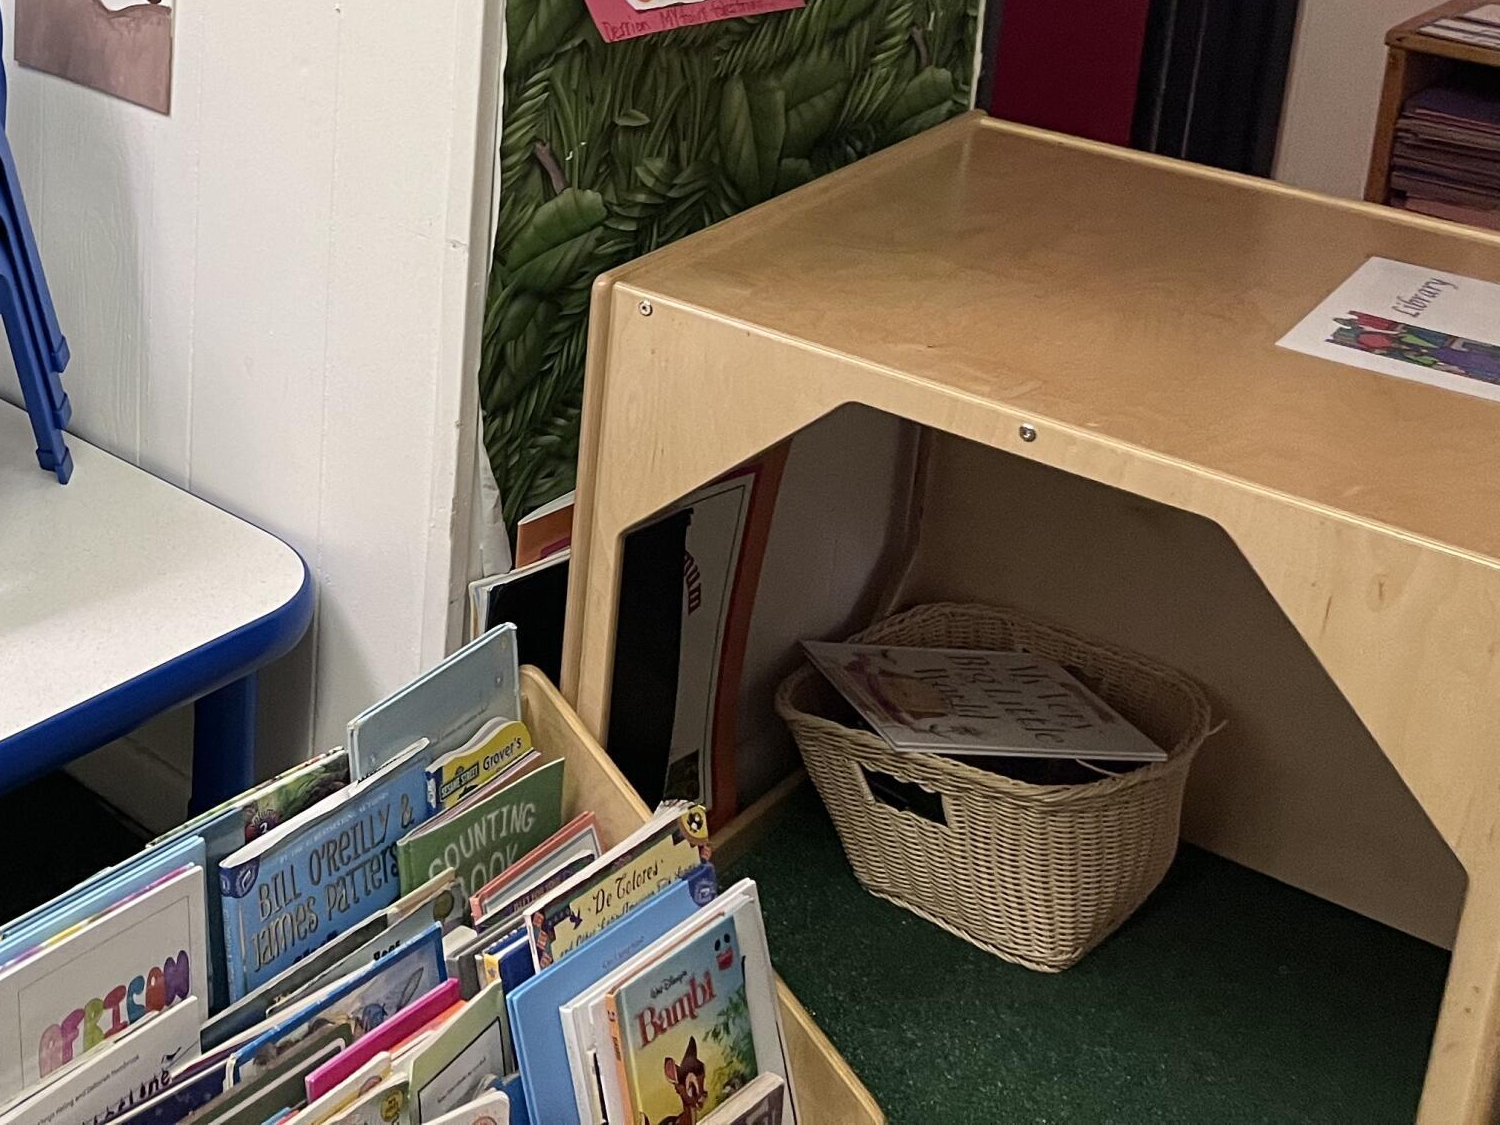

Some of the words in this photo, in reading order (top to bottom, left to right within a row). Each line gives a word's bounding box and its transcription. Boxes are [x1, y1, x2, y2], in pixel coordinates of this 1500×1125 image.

[1390, 277, 1458, 318] Library
[482, 737, 522, 771] Grover's
[258, 864, 302, 922] BILL
[401, 793, 414, 829] &
[428, 801, 536, 879] COUNTING
[592, 888, 612, 915] De
[38, 949, 190, 1079] AFRICAN
[634, 969, 717, 1048] Bambi
